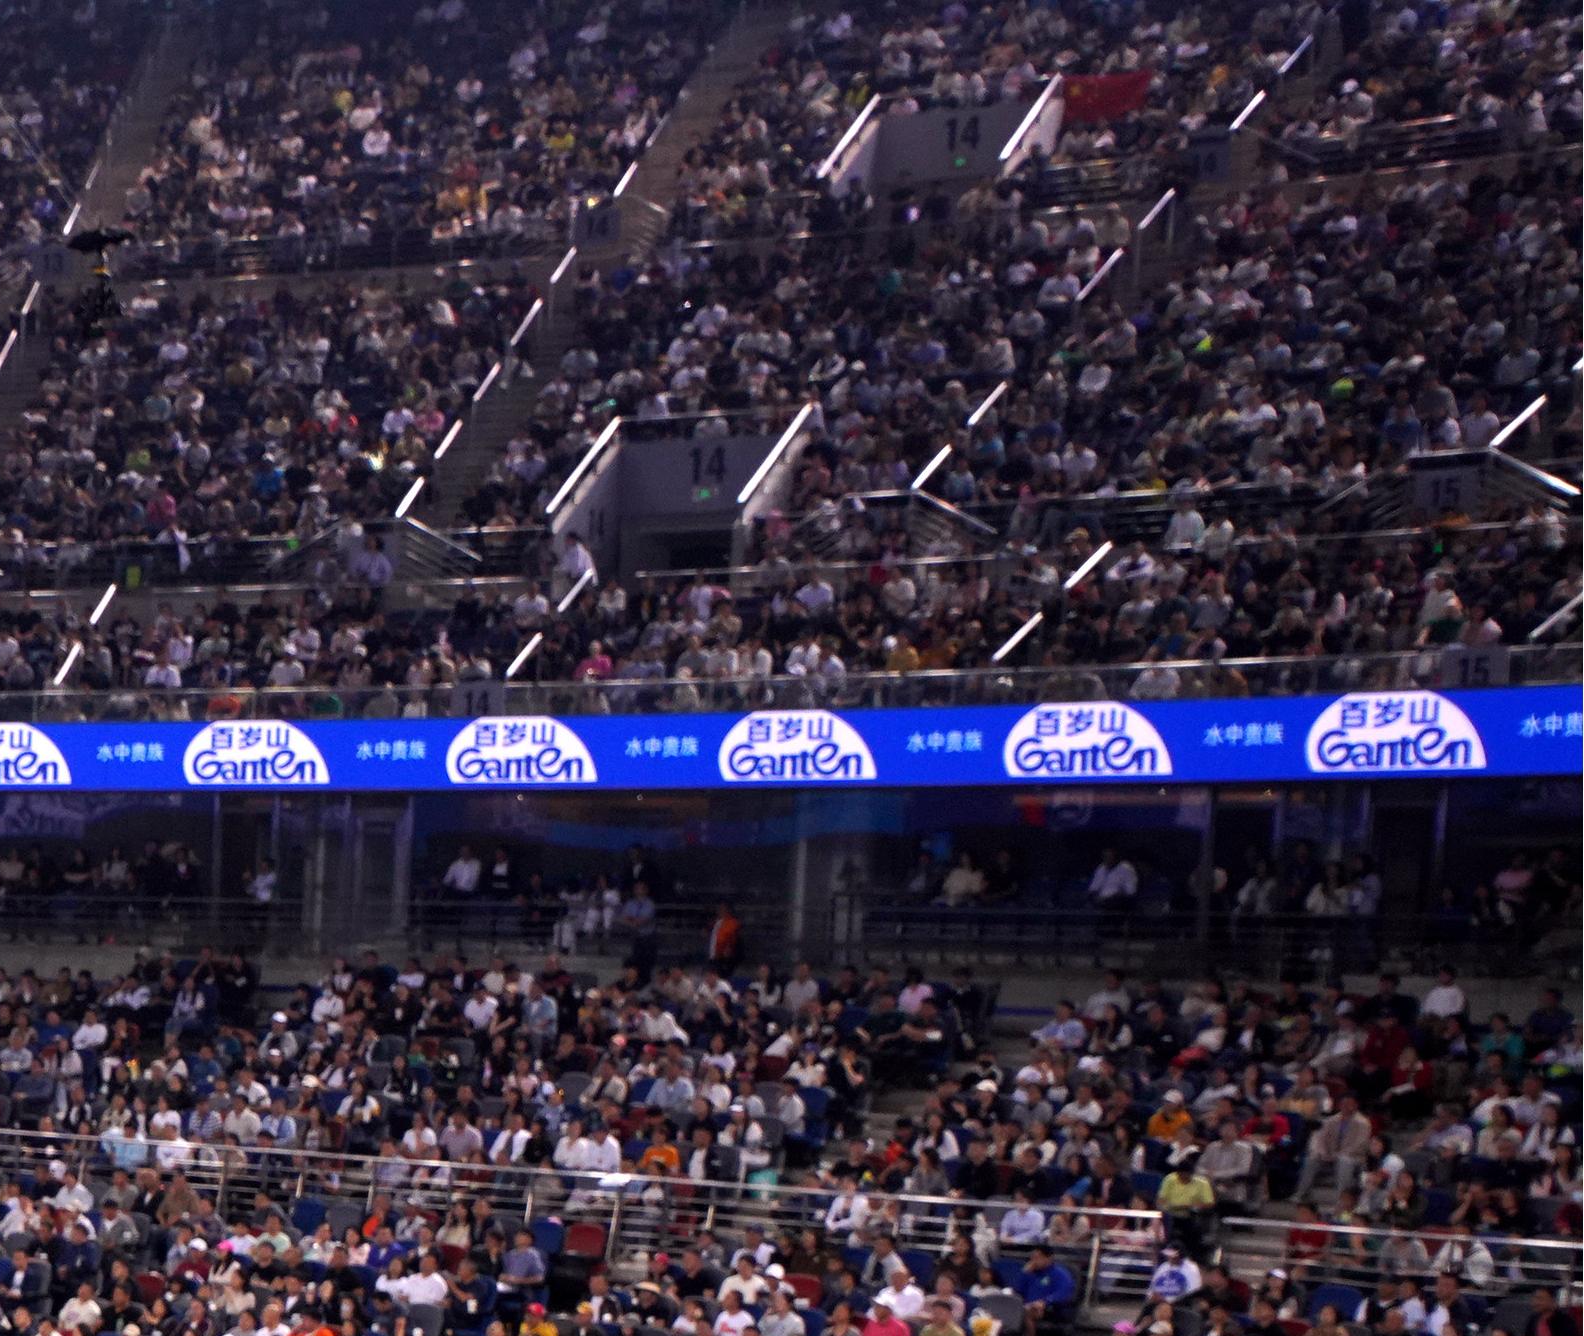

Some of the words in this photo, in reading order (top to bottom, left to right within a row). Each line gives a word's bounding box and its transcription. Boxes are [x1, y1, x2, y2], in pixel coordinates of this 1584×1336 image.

[946, 117, 980, 149] 14
[688, 448, 726, 486] 14
[1459, 656, 1489, 685] 15
[1035, 709, 1127, 736] 百岁山
[1341, 697, 1440, 728] 百岁山
[211, 727, 290, 749] 百岁山
[475, 723, 556, 746] 百岁山
[747, 718, 833, 742] 百岁山
[906, 731, 982, 753] 水中贵族
[1203, 723, 1284, 745] 水中贵族
[625, 736, 699, 758] 水中贵族
